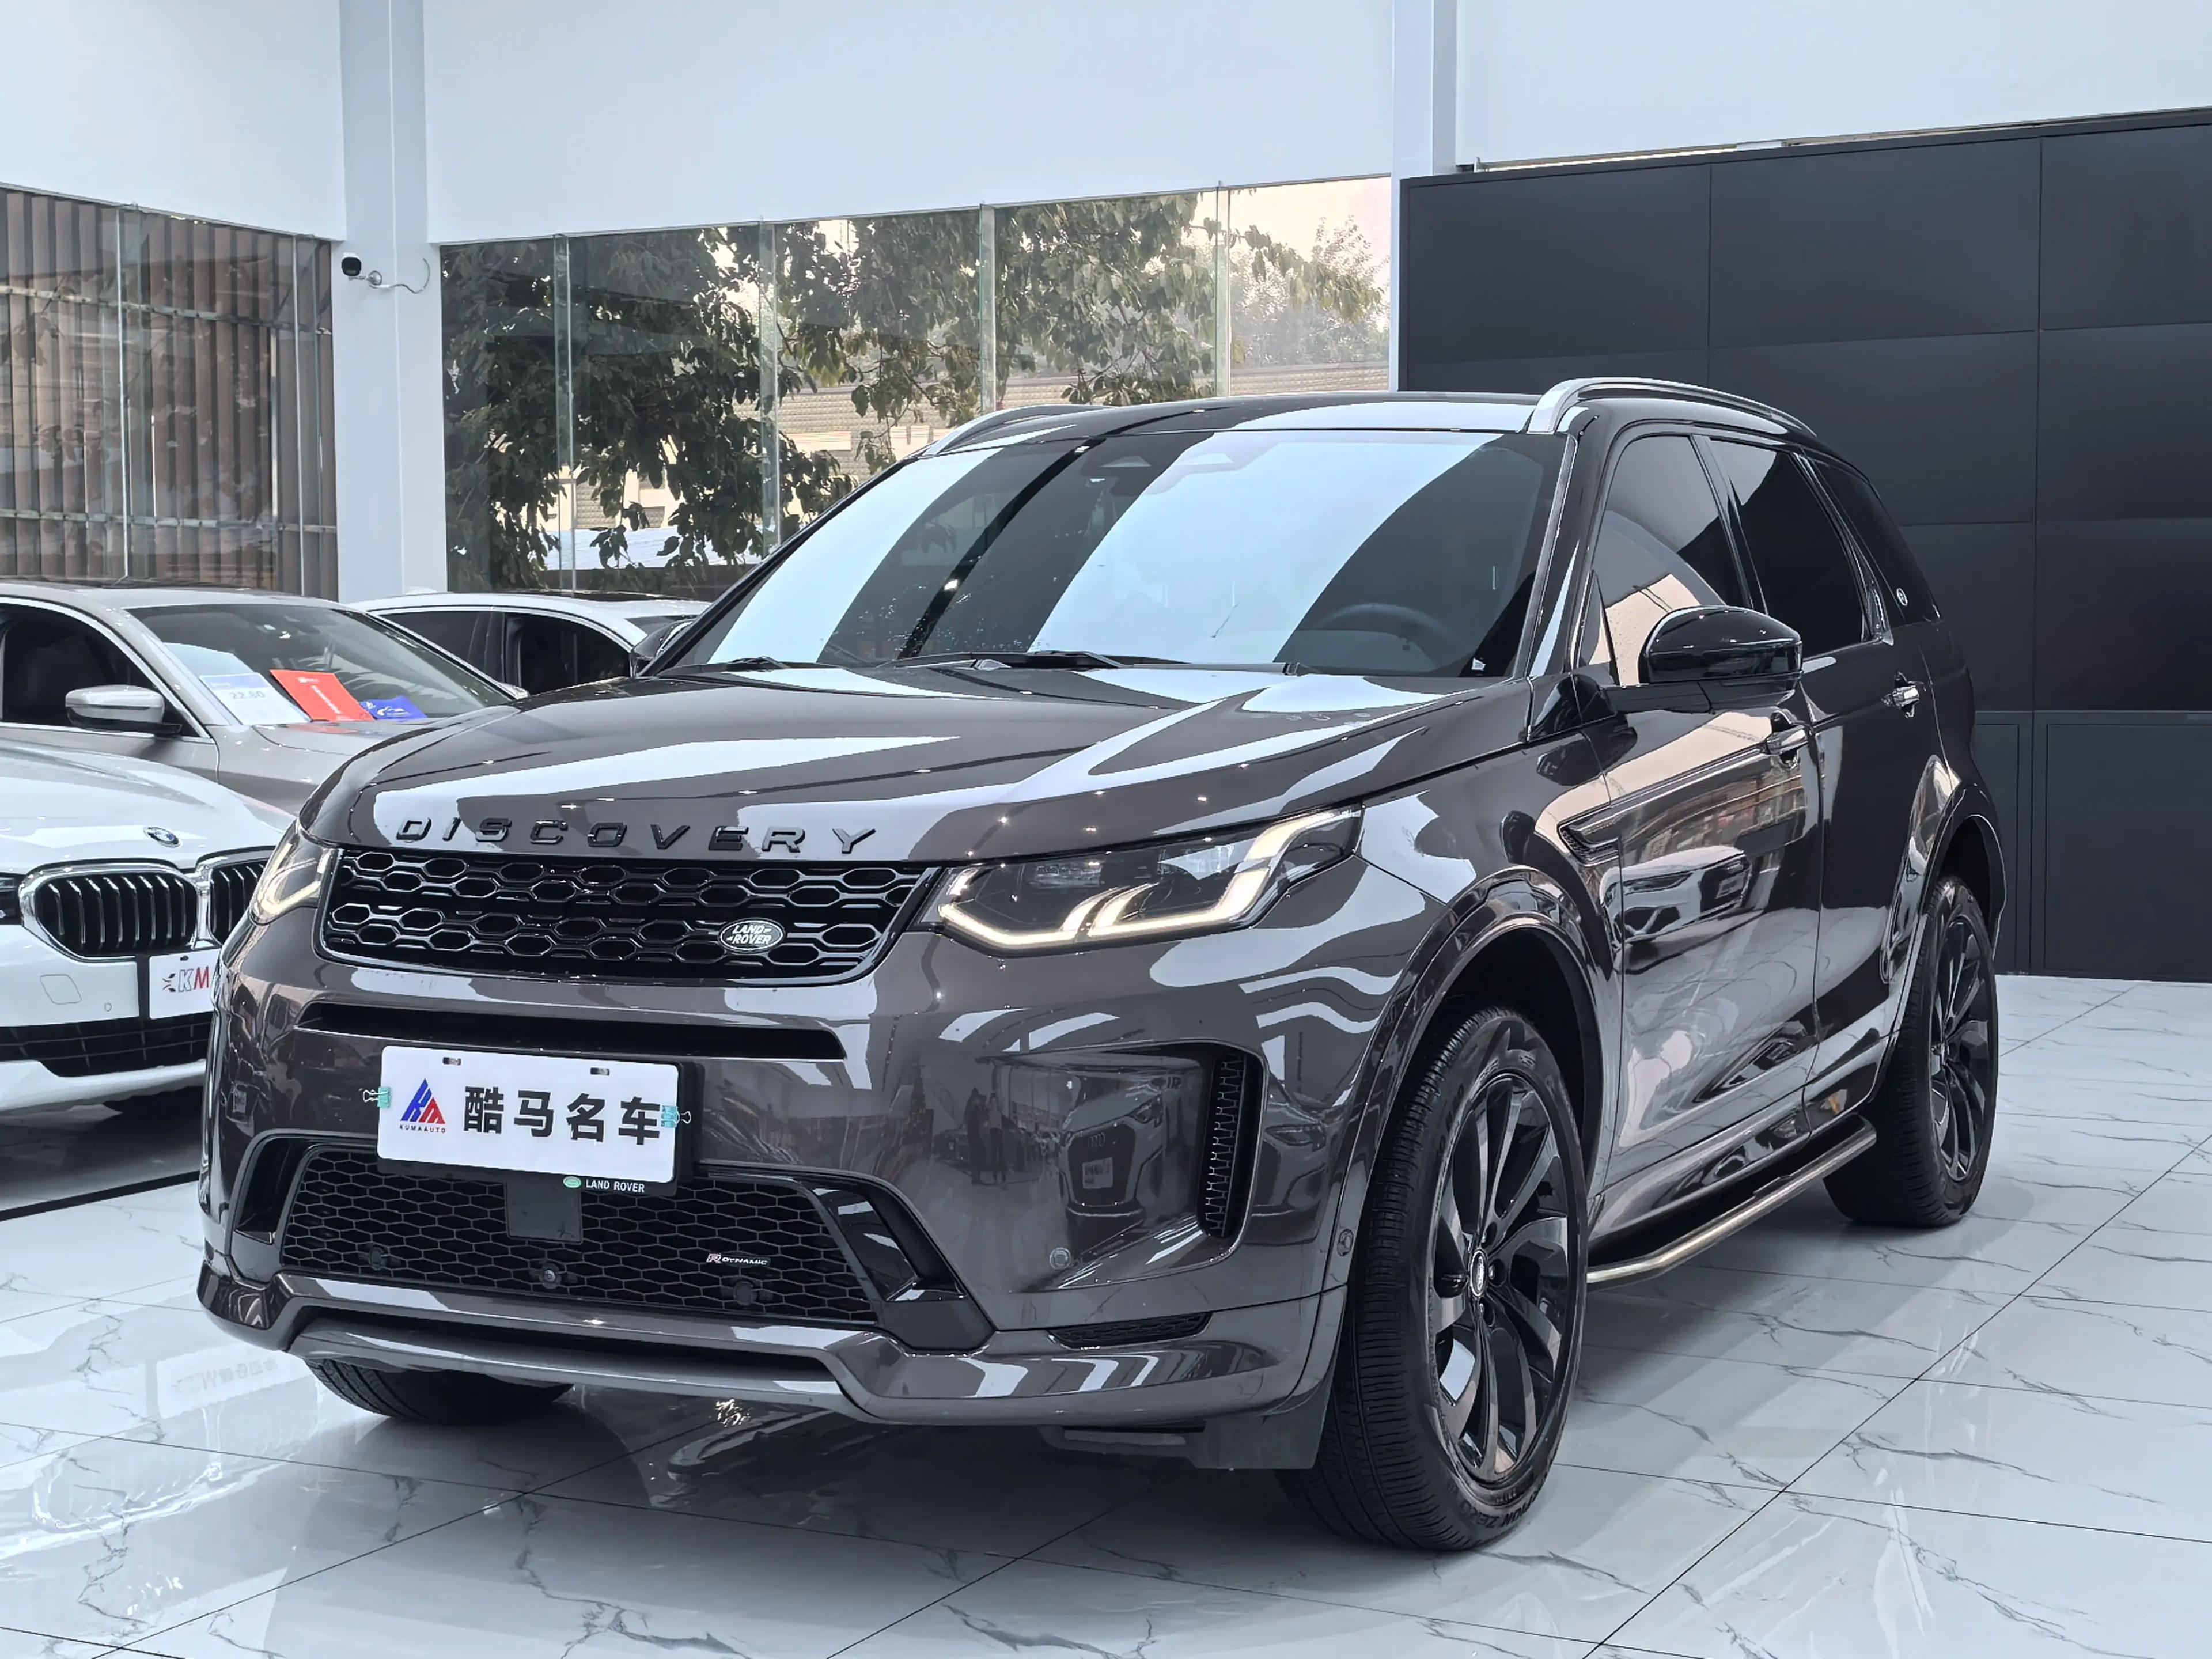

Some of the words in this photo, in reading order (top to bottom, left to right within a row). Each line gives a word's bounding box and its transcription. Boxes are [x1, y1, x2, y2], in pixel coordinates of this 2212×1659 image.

[396, 817, 876, 854] DISCOVERY
[732, 925, 765, 934] LAND
[732, 934, 772, 944] ROVER
[463, 1086, 660, 1145] 酷马名车
[399, 1125, 446, 1134] KUMAAUTO
[586, 1179, 610, 1190] LAND
[613, 1181, 645, 1193] ROVER
